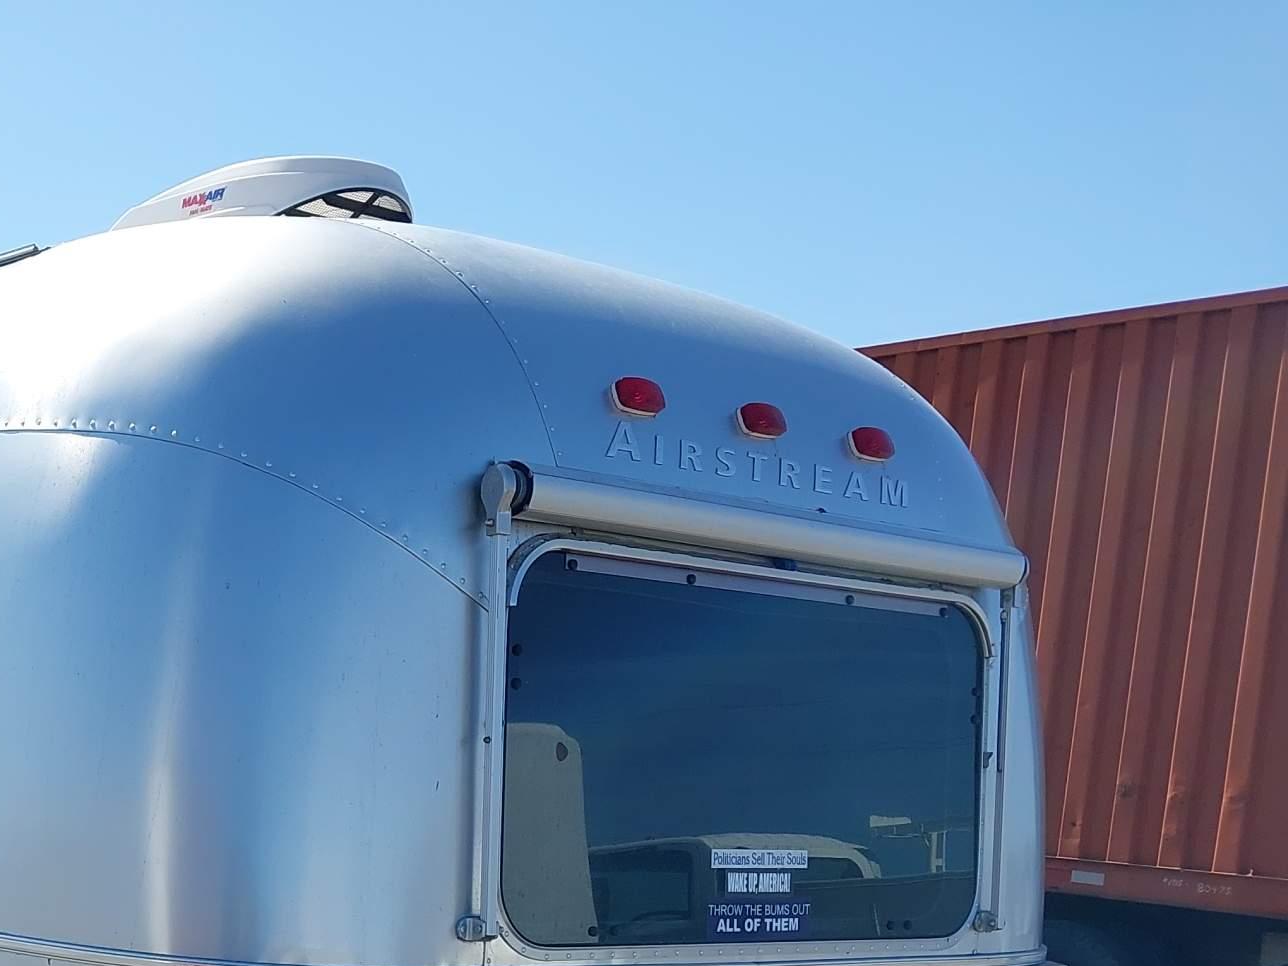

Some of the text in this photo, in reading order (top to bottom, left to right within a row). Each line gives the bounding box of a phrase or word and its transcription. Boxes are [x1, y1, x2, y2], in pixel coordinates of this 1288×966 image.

[606, 420, 909, 508] AIRSTREAM
[712, 852, 807, 866] Politicians Sell Their Souls
[727, 872, 748, 893] WAKE
[758, 872, 791, 893] AMERICA!
[708, 903, 810, 916] THROW THE BUMS OUT
[716, 917, 799, 932] ALL OF THEM
